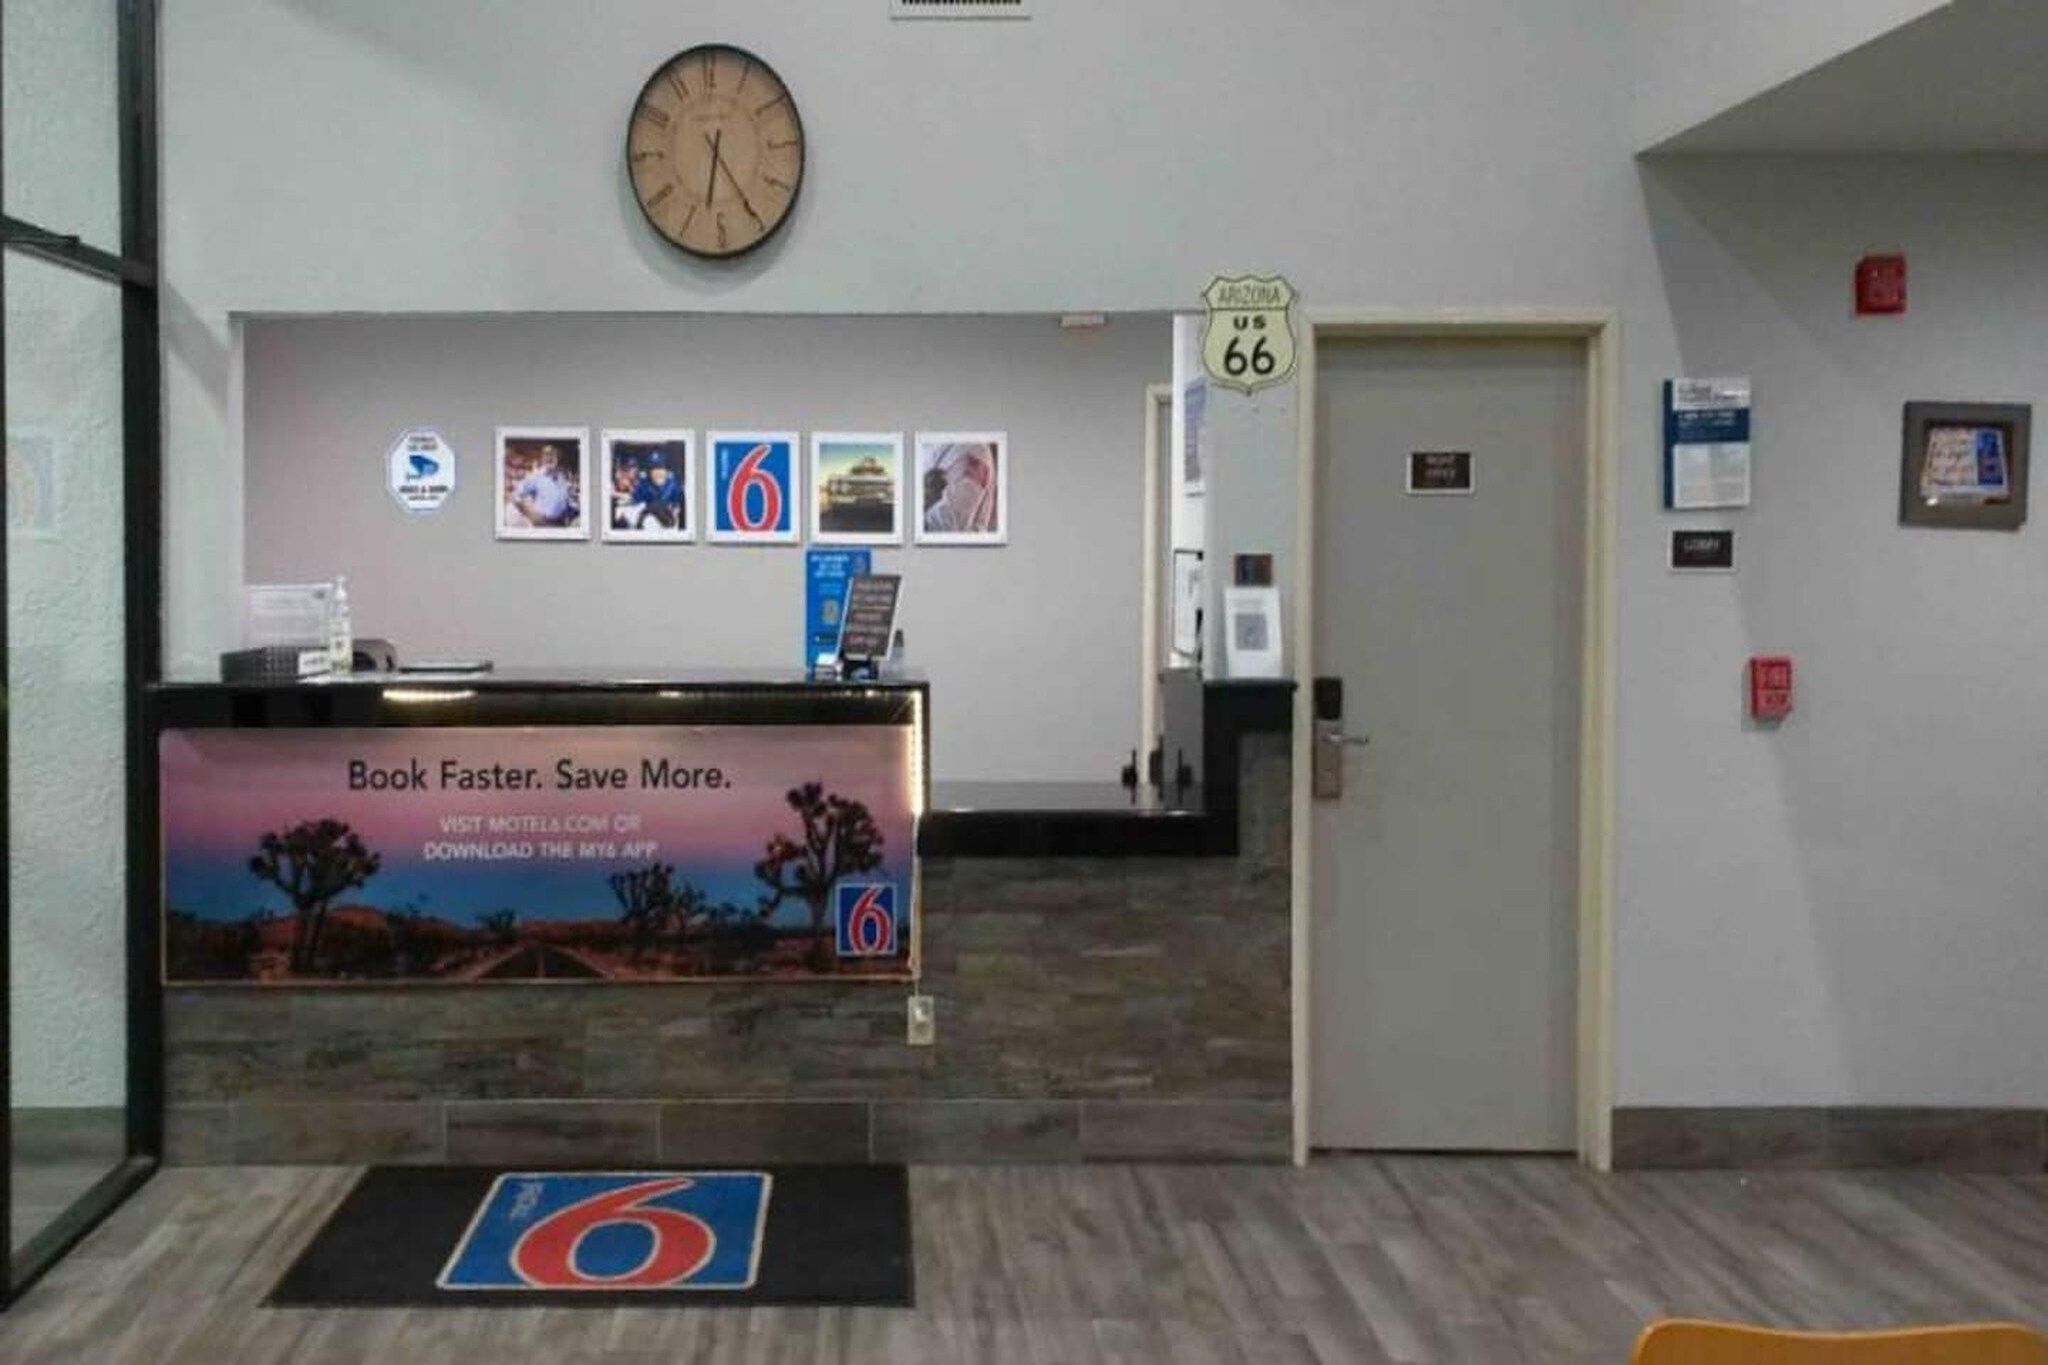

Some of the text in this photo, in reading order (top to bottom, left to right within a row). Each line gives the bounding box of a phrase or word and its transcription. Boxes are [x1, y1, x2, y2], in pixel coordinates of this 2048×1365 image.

[1218, 283, 1282, 304] ARIZONA
[1224, 336, 1275, 376] 66
[727, 442, 783, 532] 6
[348, 757, 732, 791] Book Faster. Save More.
[439, 814, 482, 833] VISIT
[614, 813, 643, 832] OR
[423, 841, 533, 860] DOWNLOAD
[540, 841, 573, 860] THE
[622, 841, 658, 859] APP
[848, 883, 892, 955] 6
[509, 1176, 717, 1290] 6
